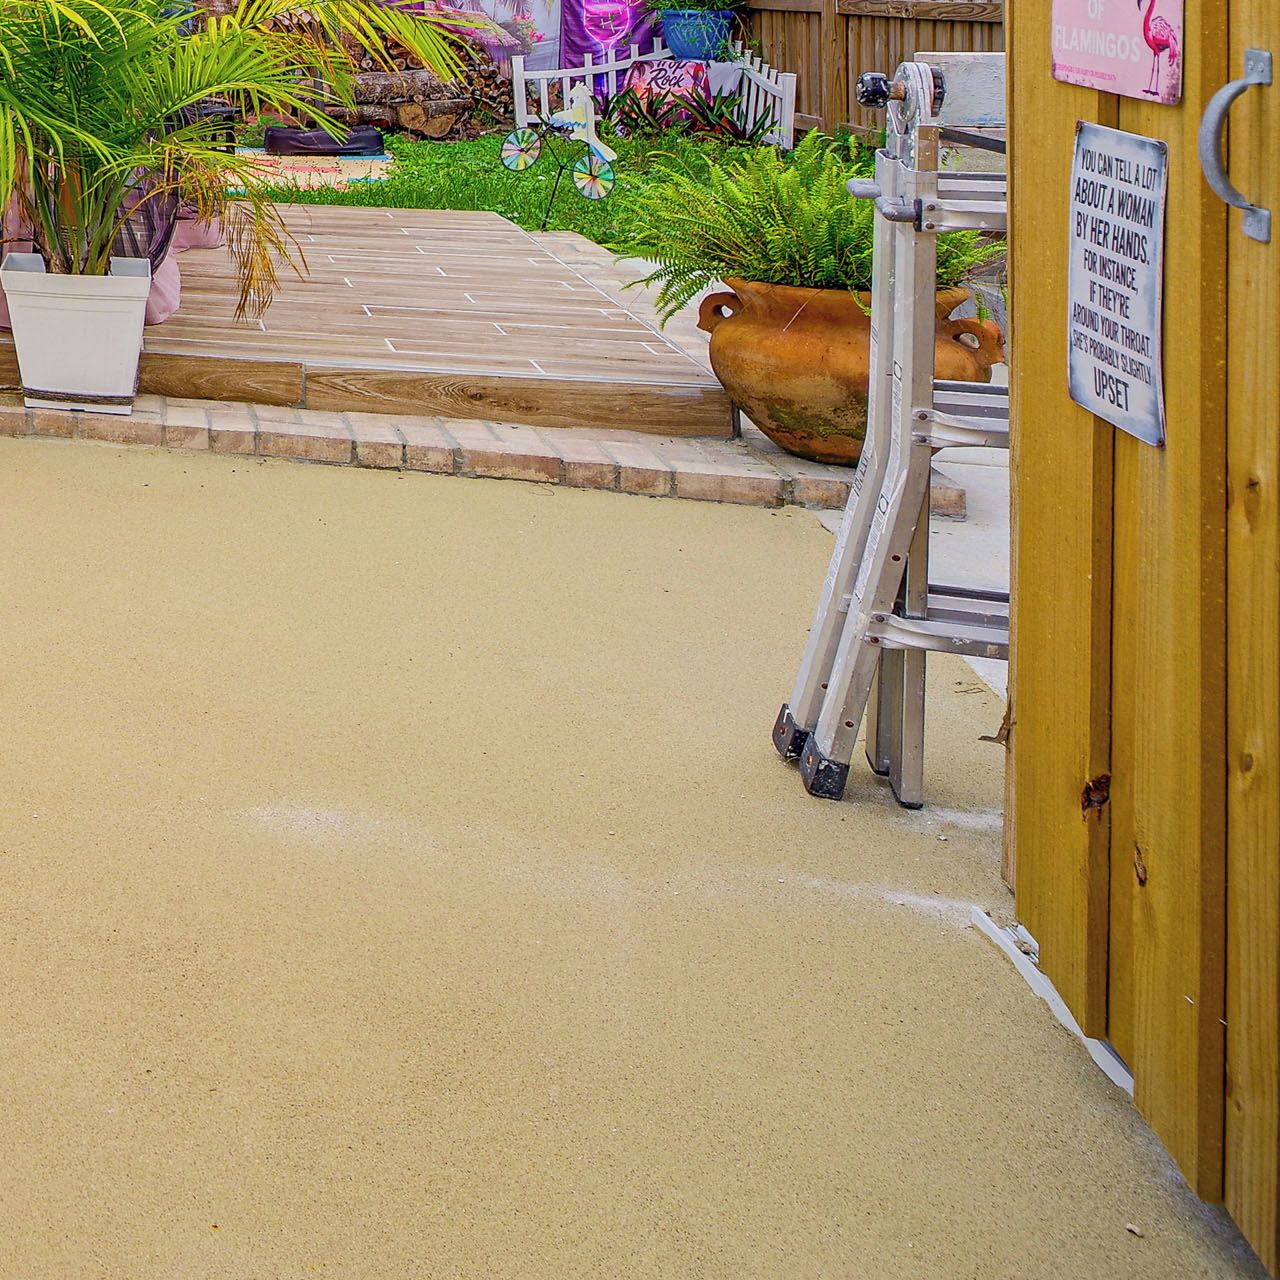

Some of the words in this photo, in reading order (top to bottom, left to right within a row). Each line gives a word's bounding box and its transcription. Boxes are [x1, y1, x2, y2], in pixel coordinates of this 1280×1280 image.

[1055, 24, 1139, 62] FLAMINGOS
[647, 68, 685, 89] Rock
[1081, 148, 1096, 172] YOU
[1098, 153, 1113, 178] CAN
[1115, 158, 1132, 184] TELL
[1134, 164, 1140, 187] A
[1142, 165, 1158, 191] LOT
[1074, 177, 1108, 210] ABOUT
[1107, 187, 1114, 214] A
[1117, 190, 1155, 228] WOMAN
[1076, 211, 1088, 240] BY
[1090, 216, 1110, 249] HER
[1112, 224, 1150, 265] HANDS.
[1084, 248, 1097, 274] FOR
[1099, 254, 1138, 295] INSTANCE,
[1089, 280, 1096, 303] IF
[1098, 284, 1130, 319] THEY'RE
[1073, 302, 1099, 332] AROUND
[1100, 315, 1119, 344] YOUR
[1073, 329, 1088, 353] SHE'S
[1089, 337, 1119, 370] PROBABLY
[1121, 353, 1152, 386] SLIGHTLY
[1093, 366, 1129, 412] UPSET
